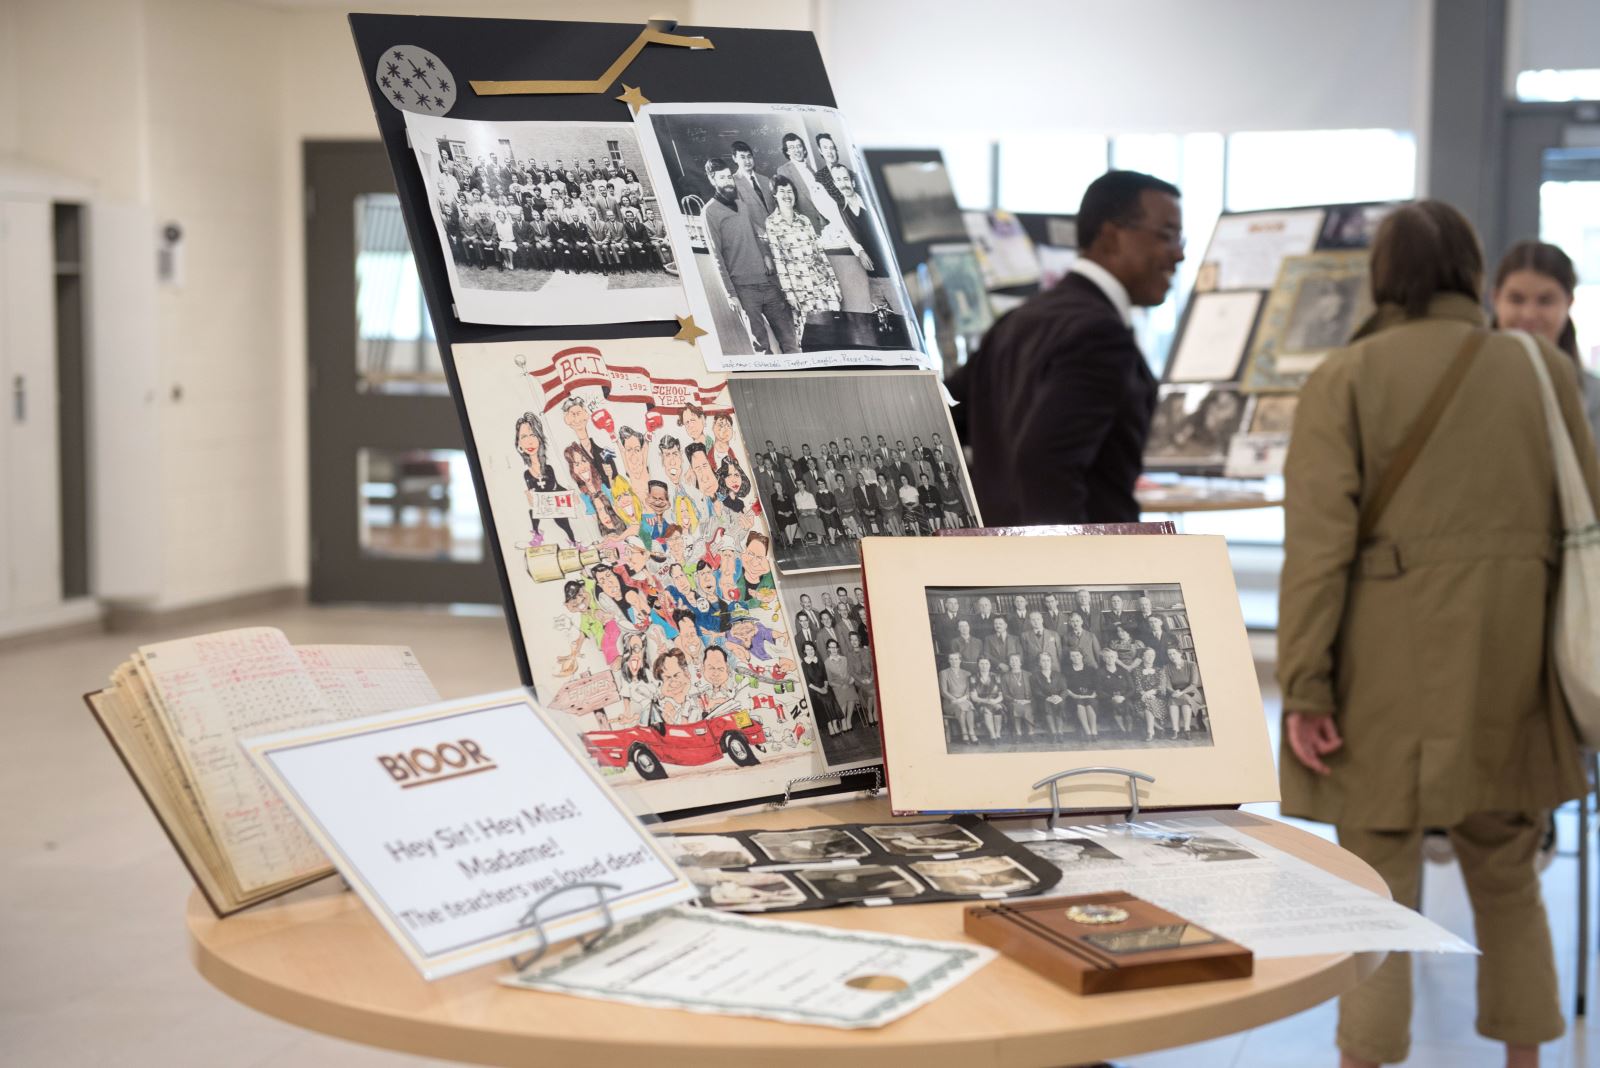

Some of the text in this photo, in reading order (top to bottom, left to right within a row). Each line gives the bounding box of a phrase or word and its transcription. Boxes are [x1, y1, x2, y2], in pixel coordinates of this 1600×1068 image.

[651, 385, 691, 396] SCHOOL
[658, 395, 688, 405] YEAR
[384, 798, 582, 863] Hey Sir! Hey Miss!
[456, 838, 565, 880] Madame!
[399, 845, 654, 931] The teachers we loved dear!
